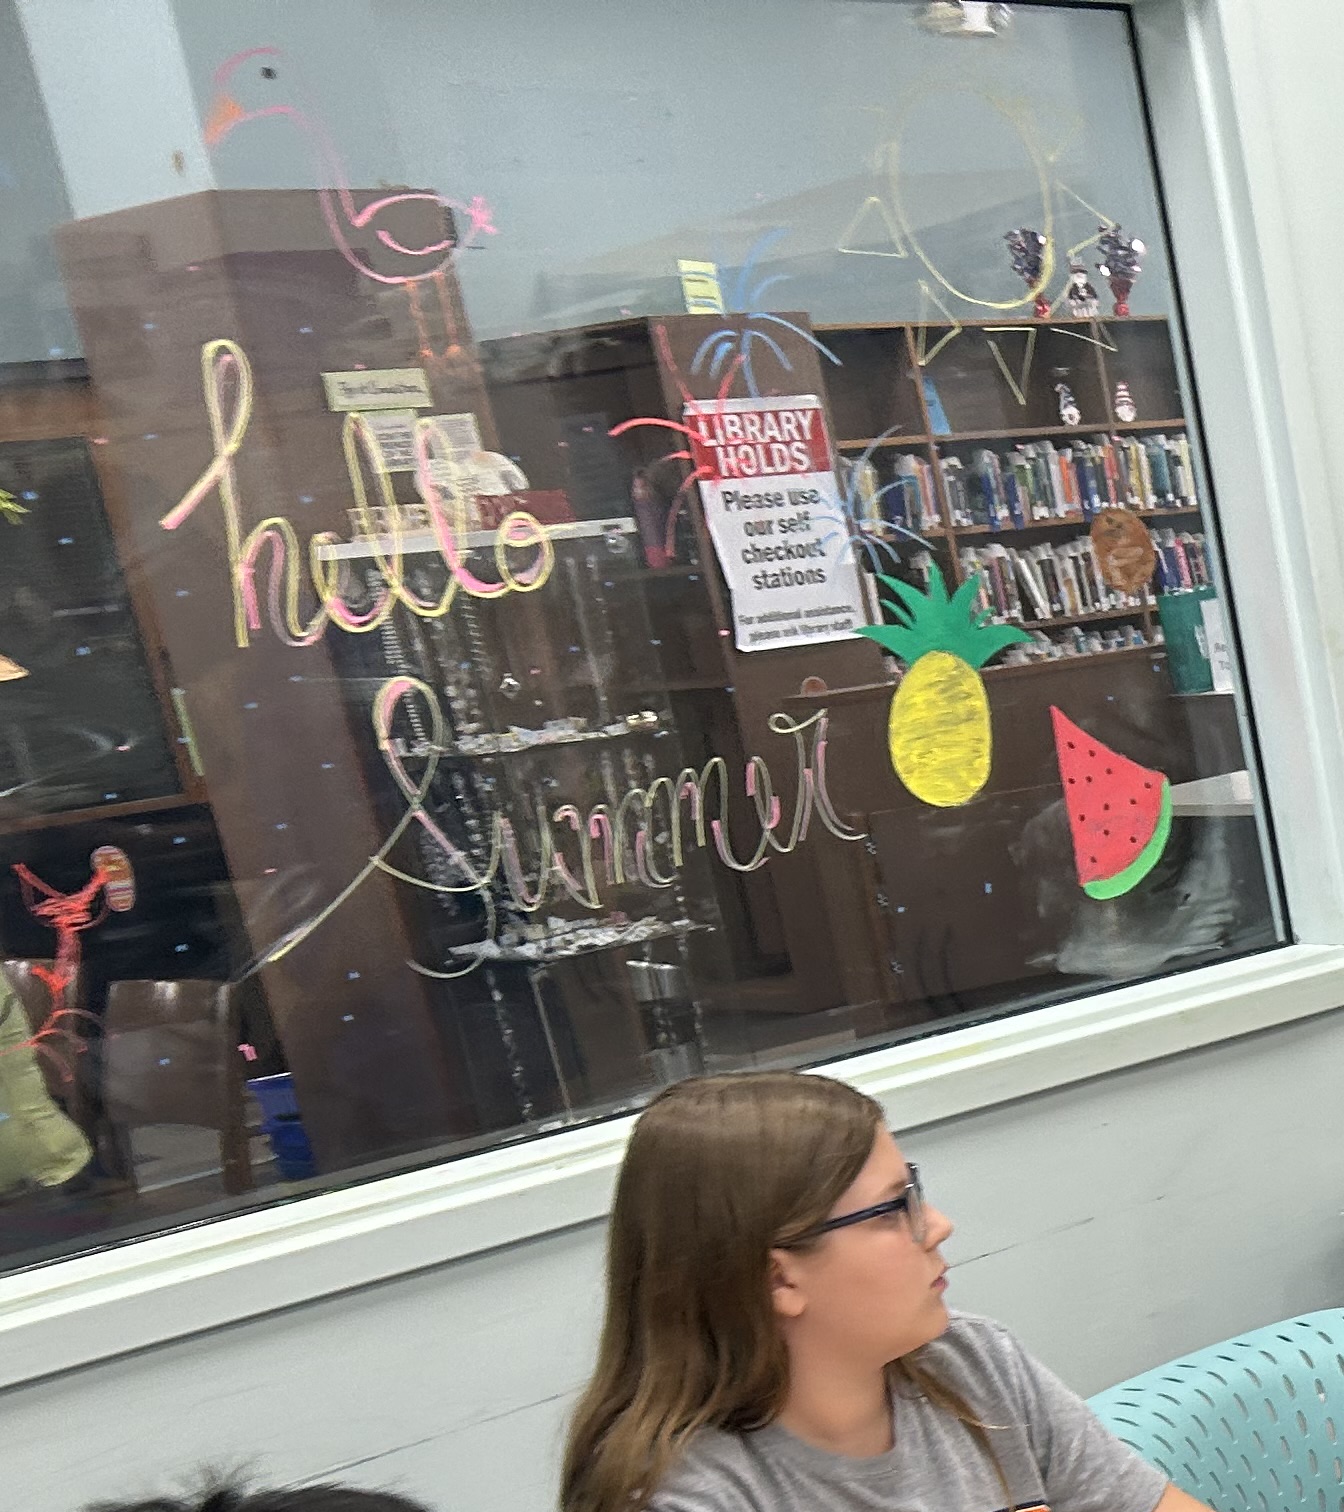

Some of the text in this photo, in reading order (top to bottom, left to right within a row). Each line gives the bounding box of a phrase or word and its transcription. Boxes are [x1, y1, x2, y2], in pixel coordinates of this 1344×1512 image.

[697, 411, 814, 447] LIBRARY
[714, 441, 811, 477] HOLDS
[159, 338, 555, 648] hello
[720, 487, 821, 512] Please use
[743, 510, 812, 537] our self
[741, 537, 827, 563] checkout
[751, 566, 828, 590] stations
